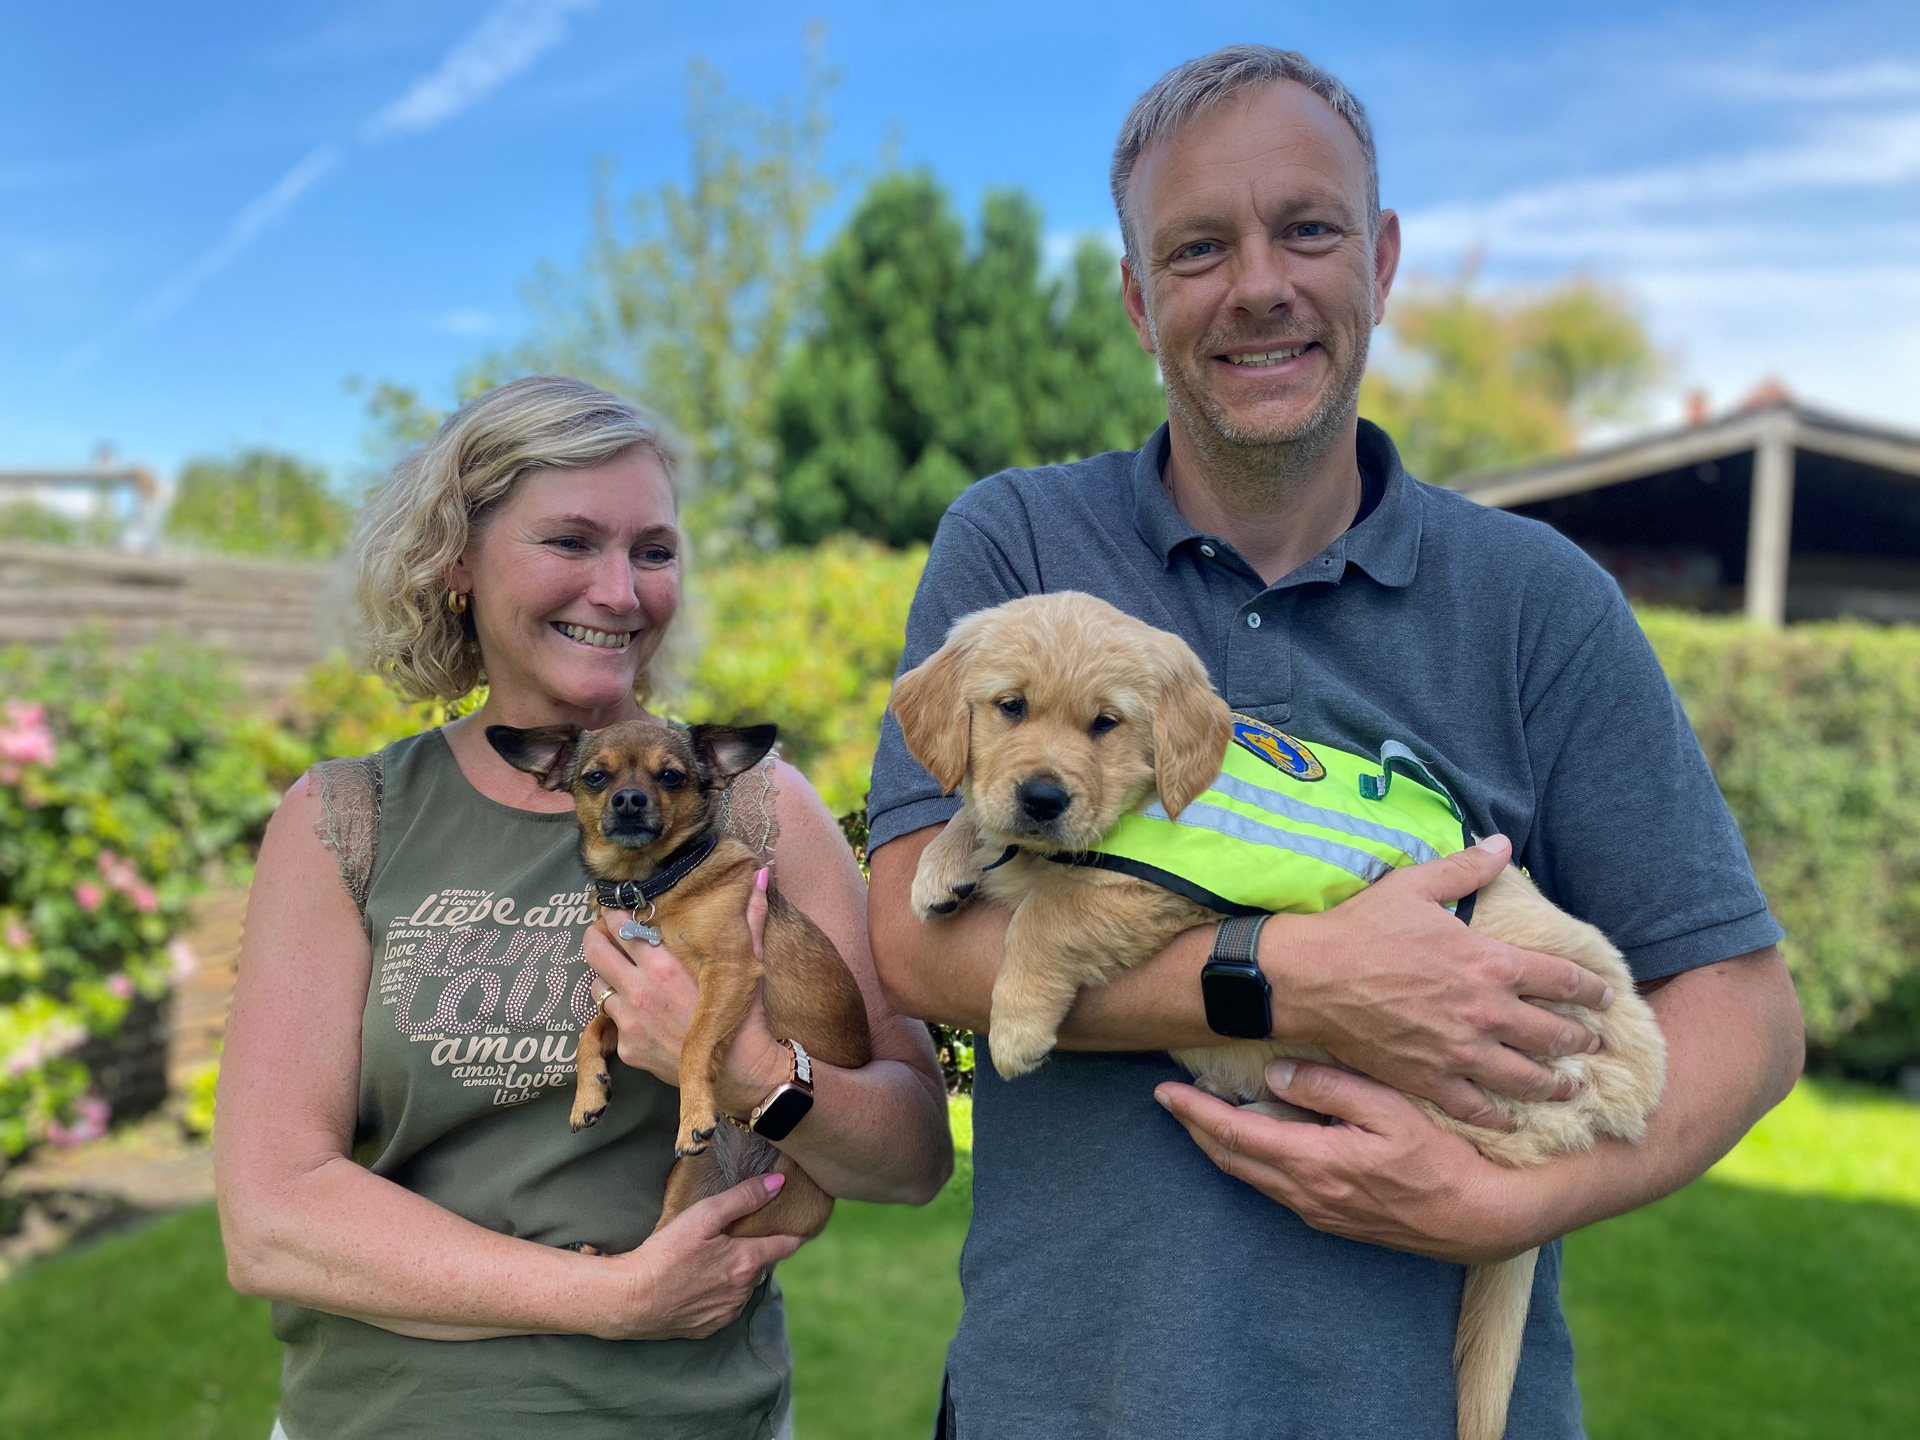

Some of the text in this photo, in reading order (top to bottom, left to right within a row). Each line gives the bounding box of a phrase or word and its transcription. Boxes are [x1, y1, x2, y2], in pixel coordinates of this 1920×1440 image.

[441, 889, 487, 897] amour
[549, 892, 590, 907] am
[450, 896, 478, 906] love
[408, 891, 521, 926] liebe
[389, 919, 407, 928] love
[449, 925, 472, 934] love
[386, 929, 432, 940] amour
[384, 941, 417, 960] love
[381, 958, 413, 972] amore
[380, 969, 406, 985] liebe
[485, 1023, 511, 1034] liebe
[545, 1019, 576, 1031] liebe
[410, 1032, 446, 1042] amore
[431, 1035, 580, 1066] amou
[451, 1064, 507, 1078] amor
[504, 1063, 568, 1089] love
[463, 1078, 504, 1087] amour
[493, 1088, 542, 1105] liebe
